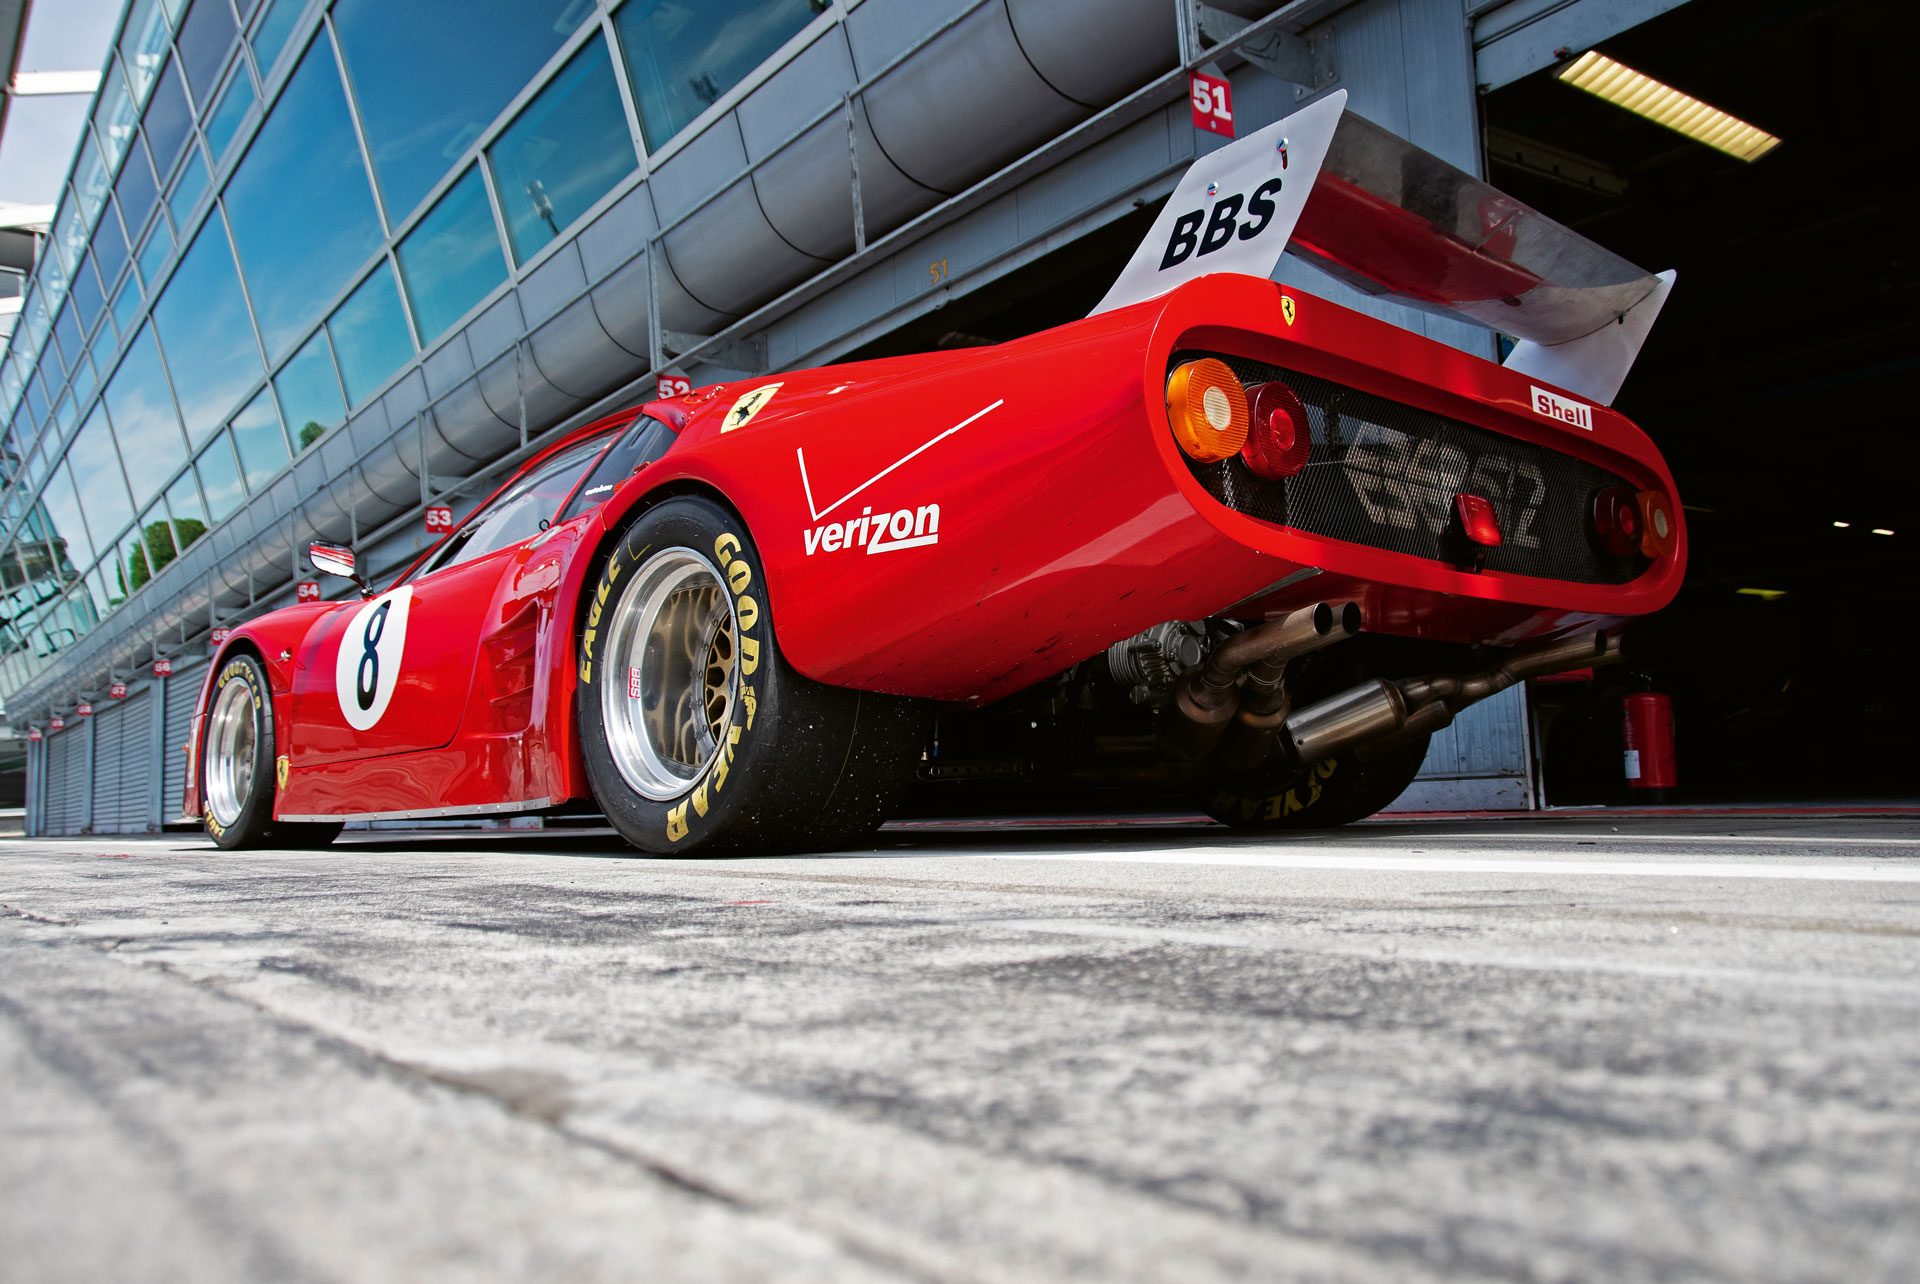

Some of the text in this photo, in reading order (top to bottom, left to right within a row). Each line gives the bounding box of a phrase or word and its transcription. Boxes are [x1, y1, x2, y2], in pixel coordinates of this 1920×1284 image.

[1193, 78, 1232, 121] 51
[1158, 177, 1283, 272] BBS
[930, 257, 948, 285] 51
[1537, 394, 1587, 427] Shell
[426, 510, 452, 526] 53
[803, 503, 940, 556] verizon
[298, 584, 319, 597] 54
[579, 547, 622, 685] EAGLE
[356, 599, 391, 711] 8
[630, 667, 641, 698] BBS
